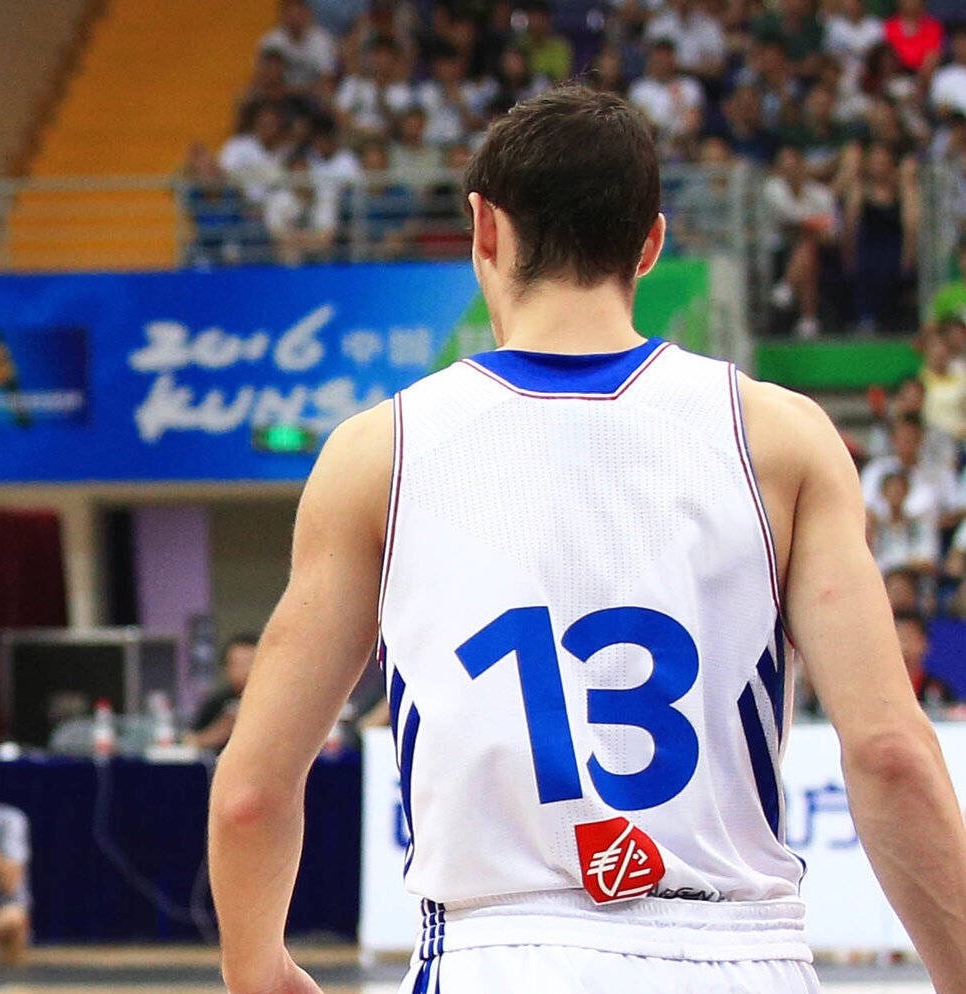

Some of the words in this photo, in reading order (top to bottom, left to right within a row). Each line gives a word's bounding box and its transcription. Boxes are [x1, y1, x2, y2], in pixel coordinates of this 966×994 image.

[130, 304, 333, 372] 2016
[136, 372, 388, 442] KUNS
[455, 606, 700, 811] 13
